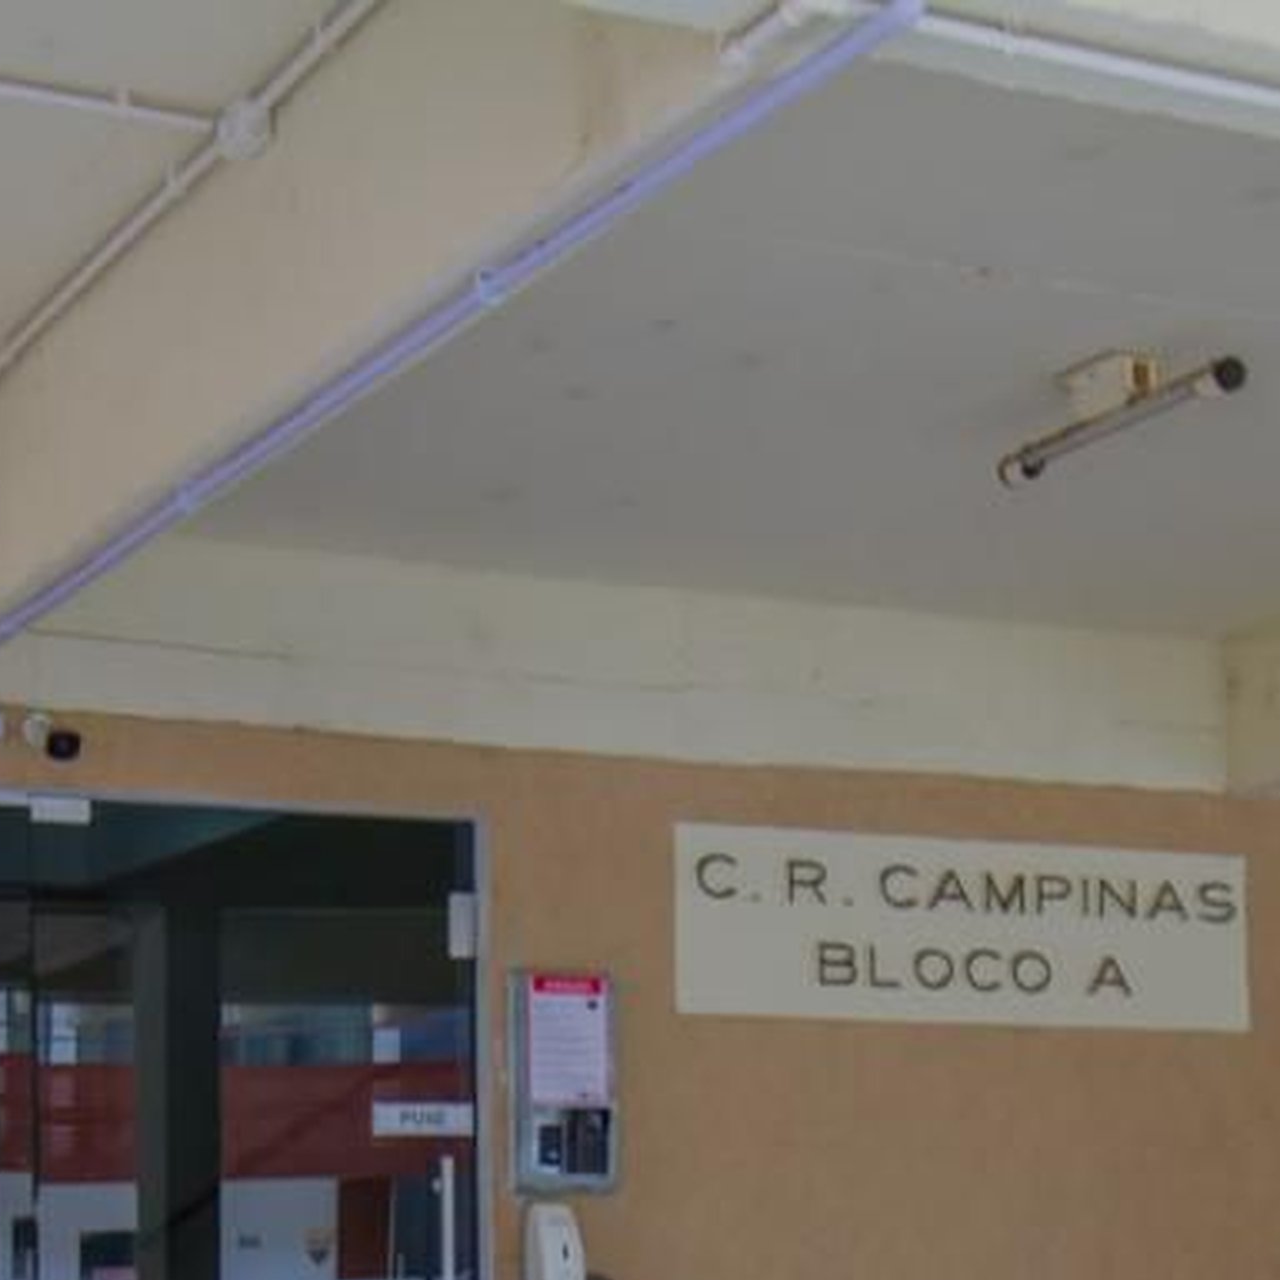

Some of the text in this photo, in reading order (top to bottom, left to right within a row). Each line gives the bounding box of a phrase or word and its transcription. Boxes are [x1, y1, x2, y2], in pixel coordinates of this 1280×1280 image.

[878, 865, 1238, 923] CAMPINAS
[816, 942, 1133, 997] BLOCO A
